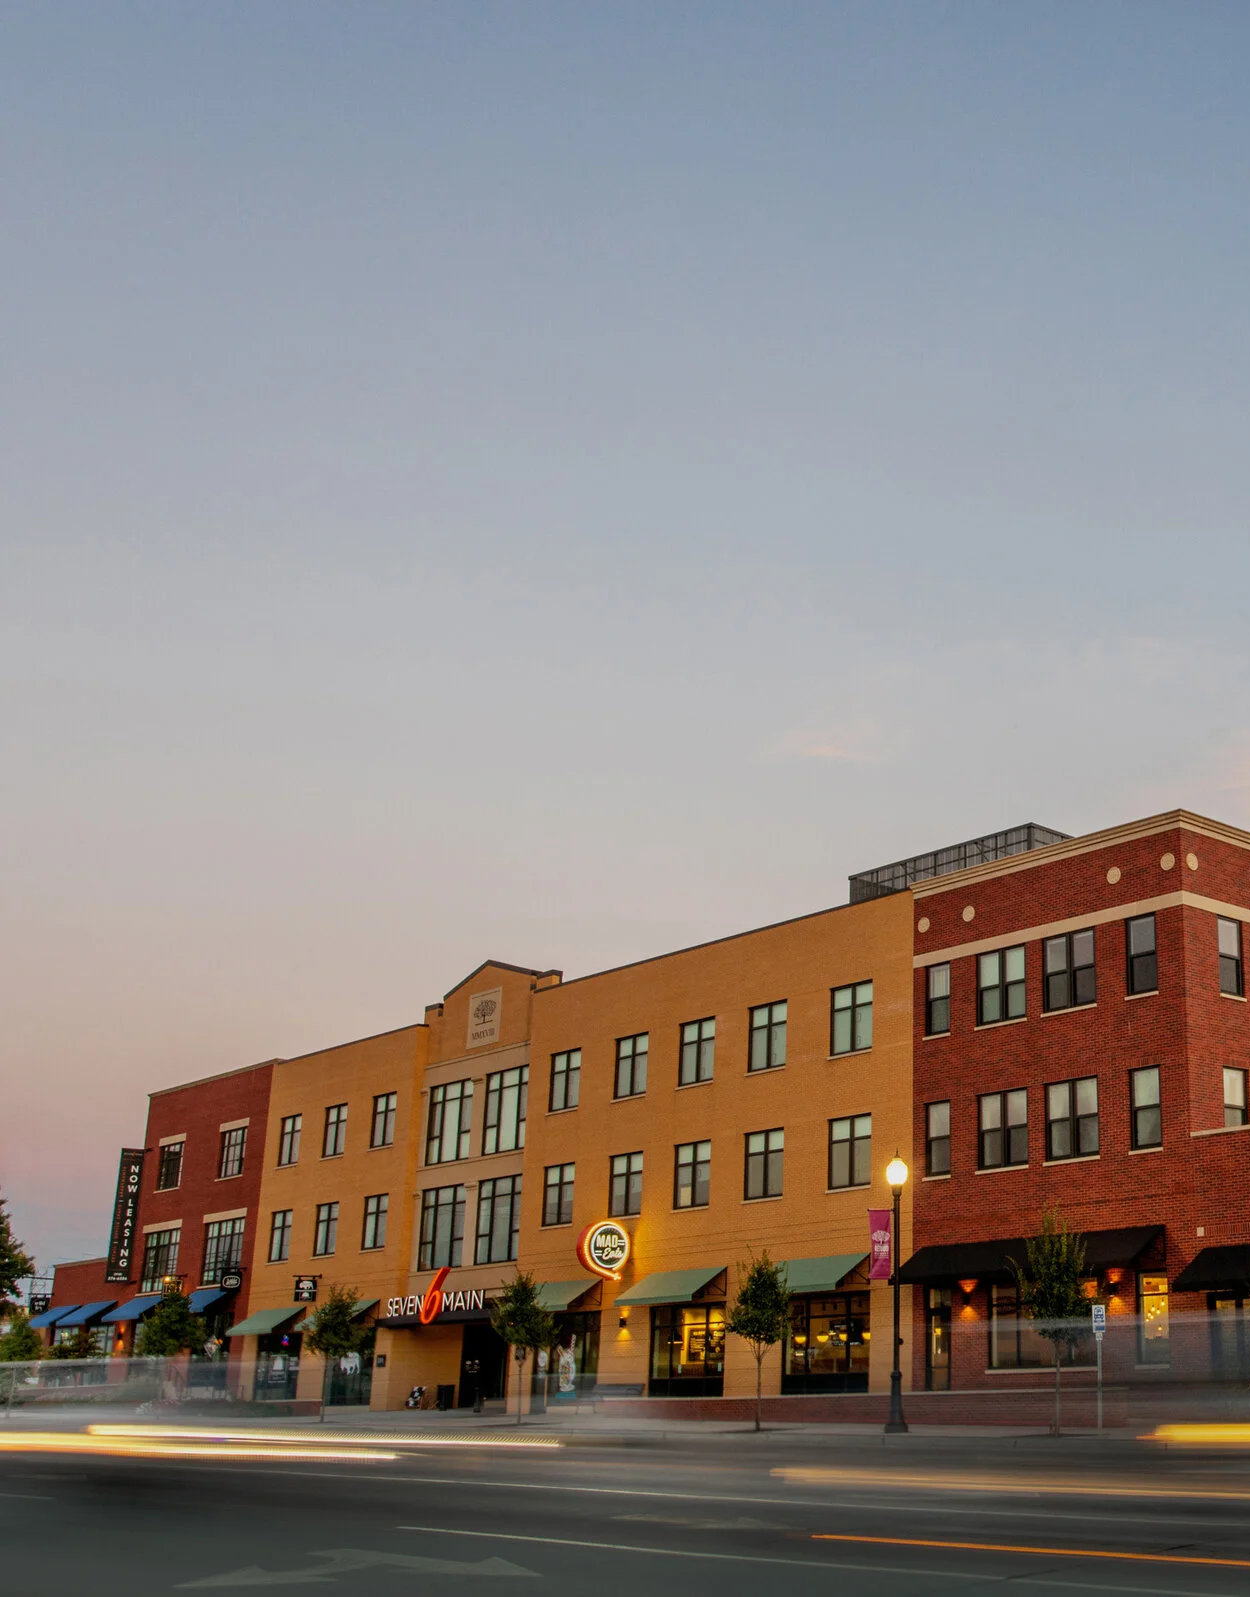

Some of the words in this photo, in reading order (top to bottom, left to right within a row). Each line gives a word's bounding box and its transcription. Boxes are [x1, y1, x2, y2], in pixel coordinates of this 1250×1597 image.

[128, 1165, 140, 1193] NOW
[118, 1198, 134, 1268] LEASING
[596, 1234, 619, 1248] MAD
[602, 1247, 624, 1260] Eats
[386, 1294, 425, 1318] SEVEN
[420, 1266, 452, 1325] 6
[441, 1289, 484, 1313] MAIN
